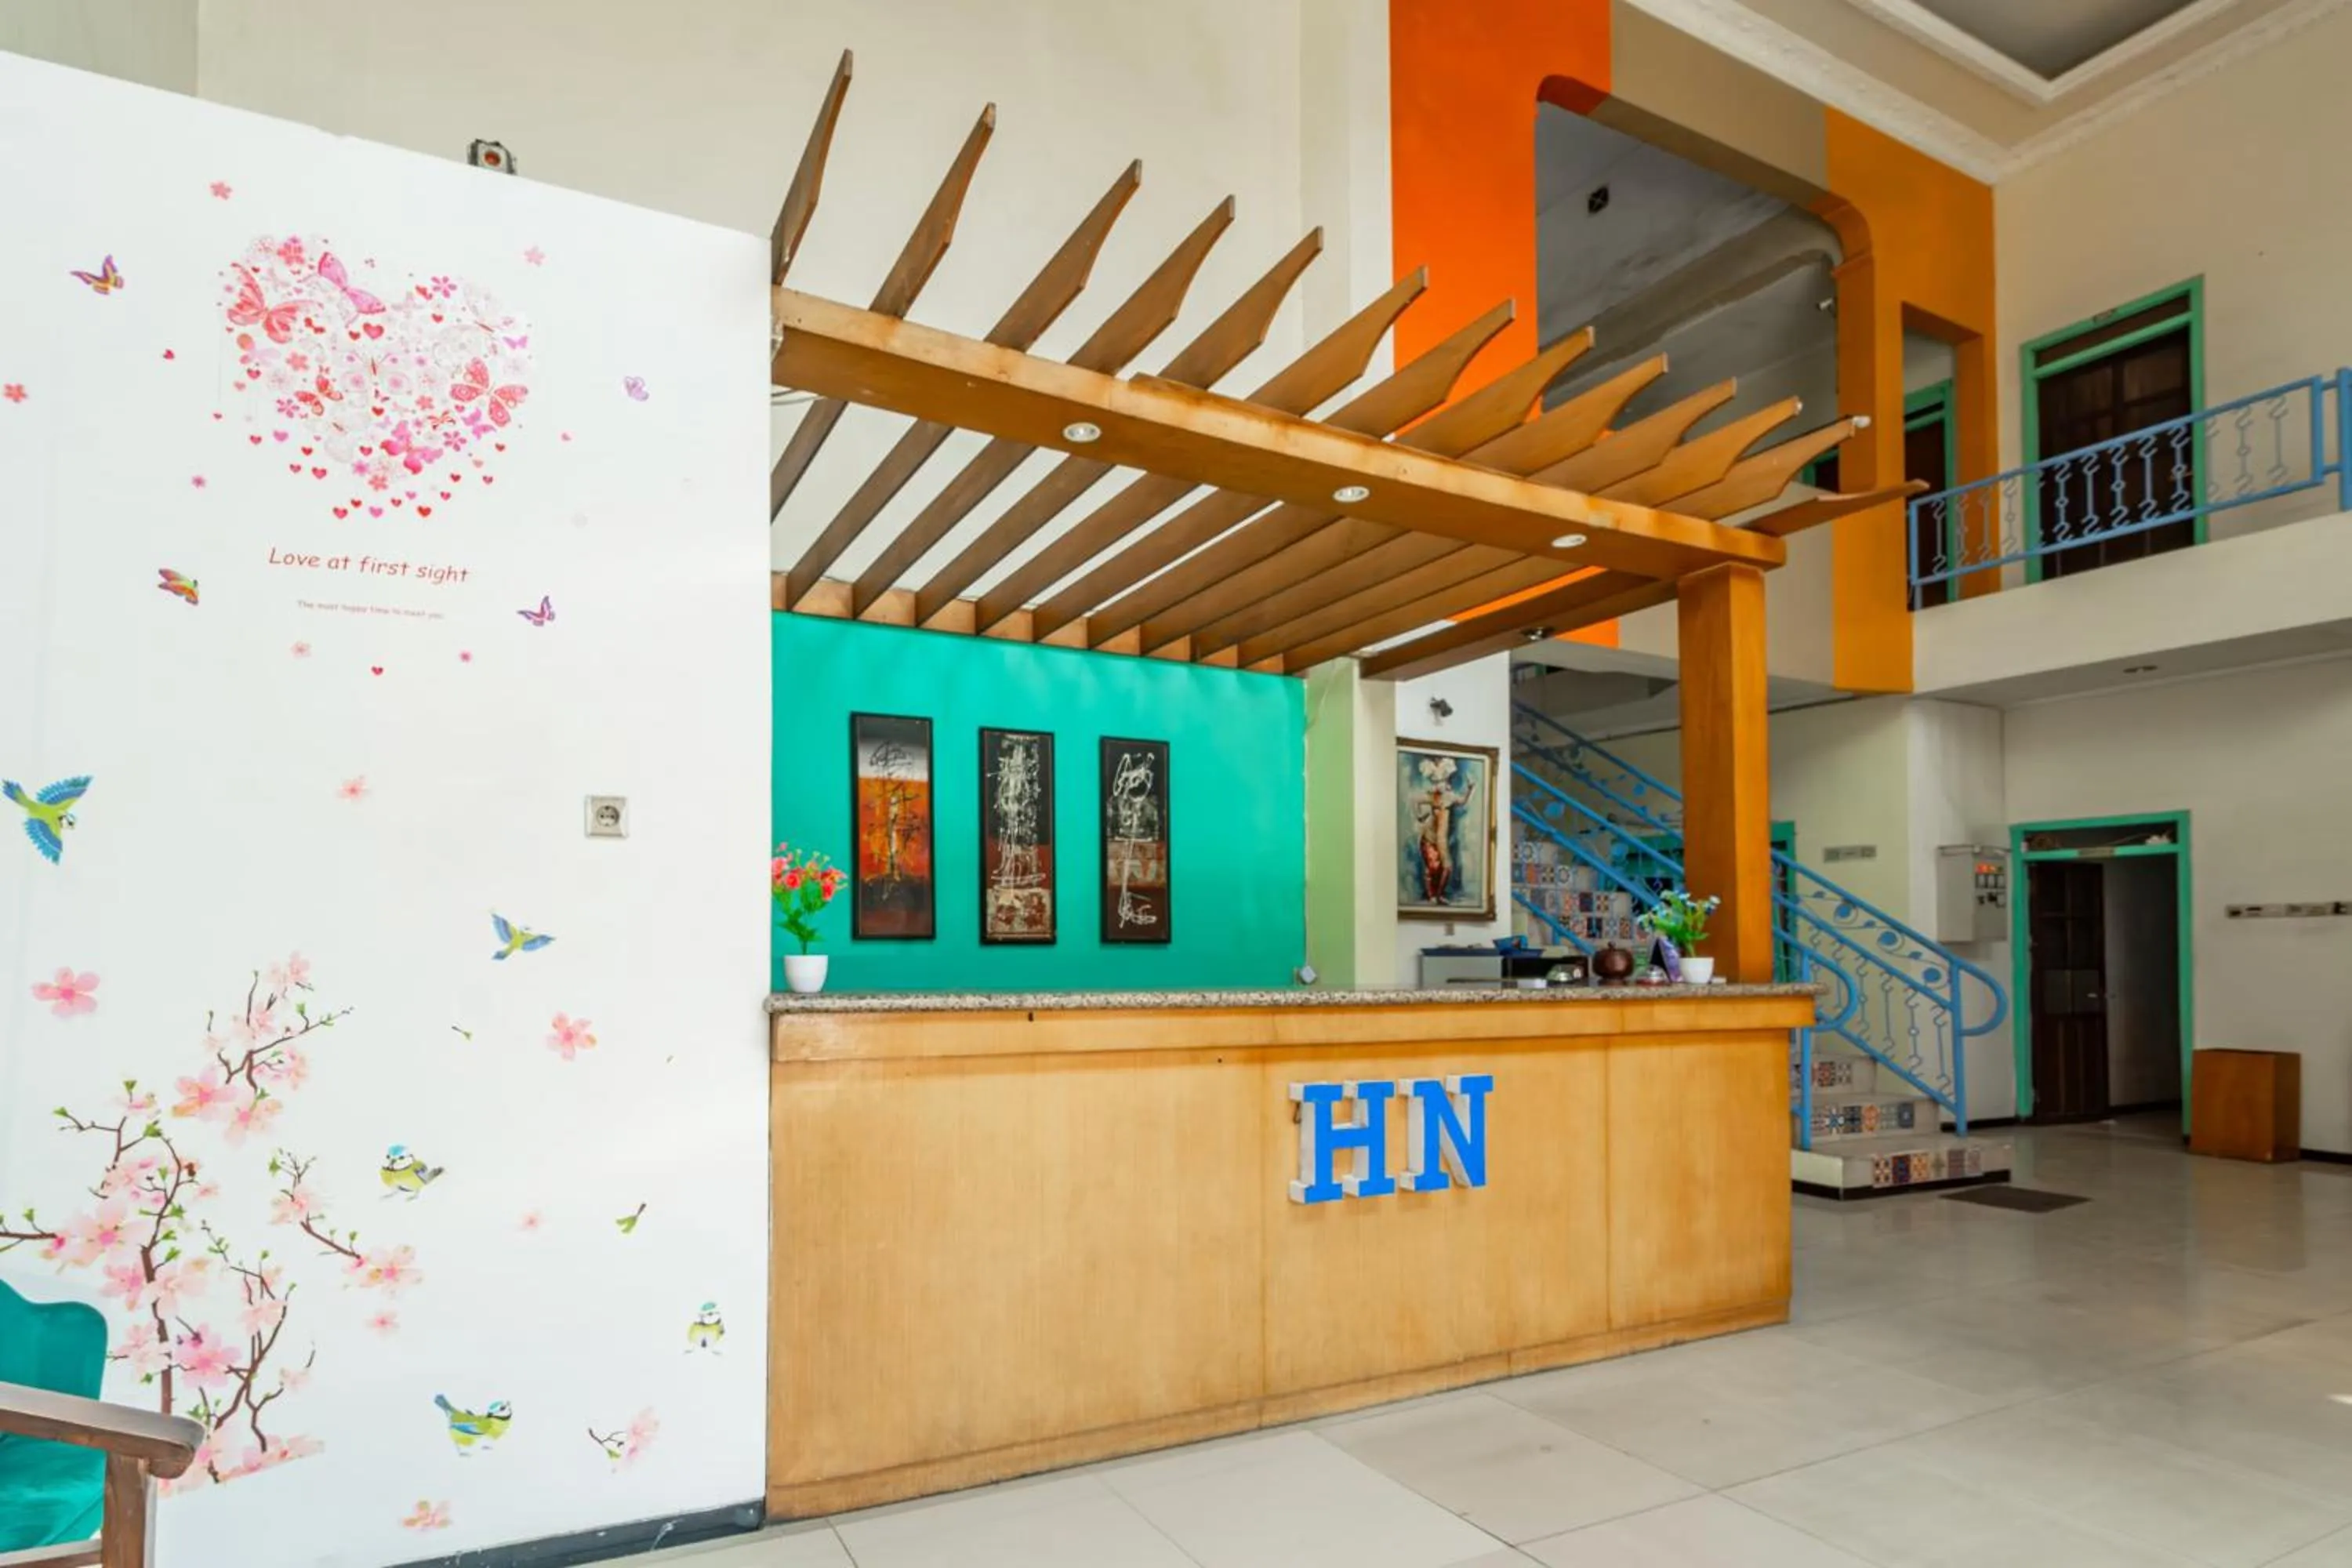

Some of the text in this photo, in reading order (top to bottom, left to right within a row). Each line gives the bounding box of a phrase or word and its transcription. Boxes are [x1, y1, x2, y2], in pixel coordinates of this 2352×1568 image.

[269, 546, 470, 585] Love at first sight
[1290, 1073, 1494, 1204] HN
